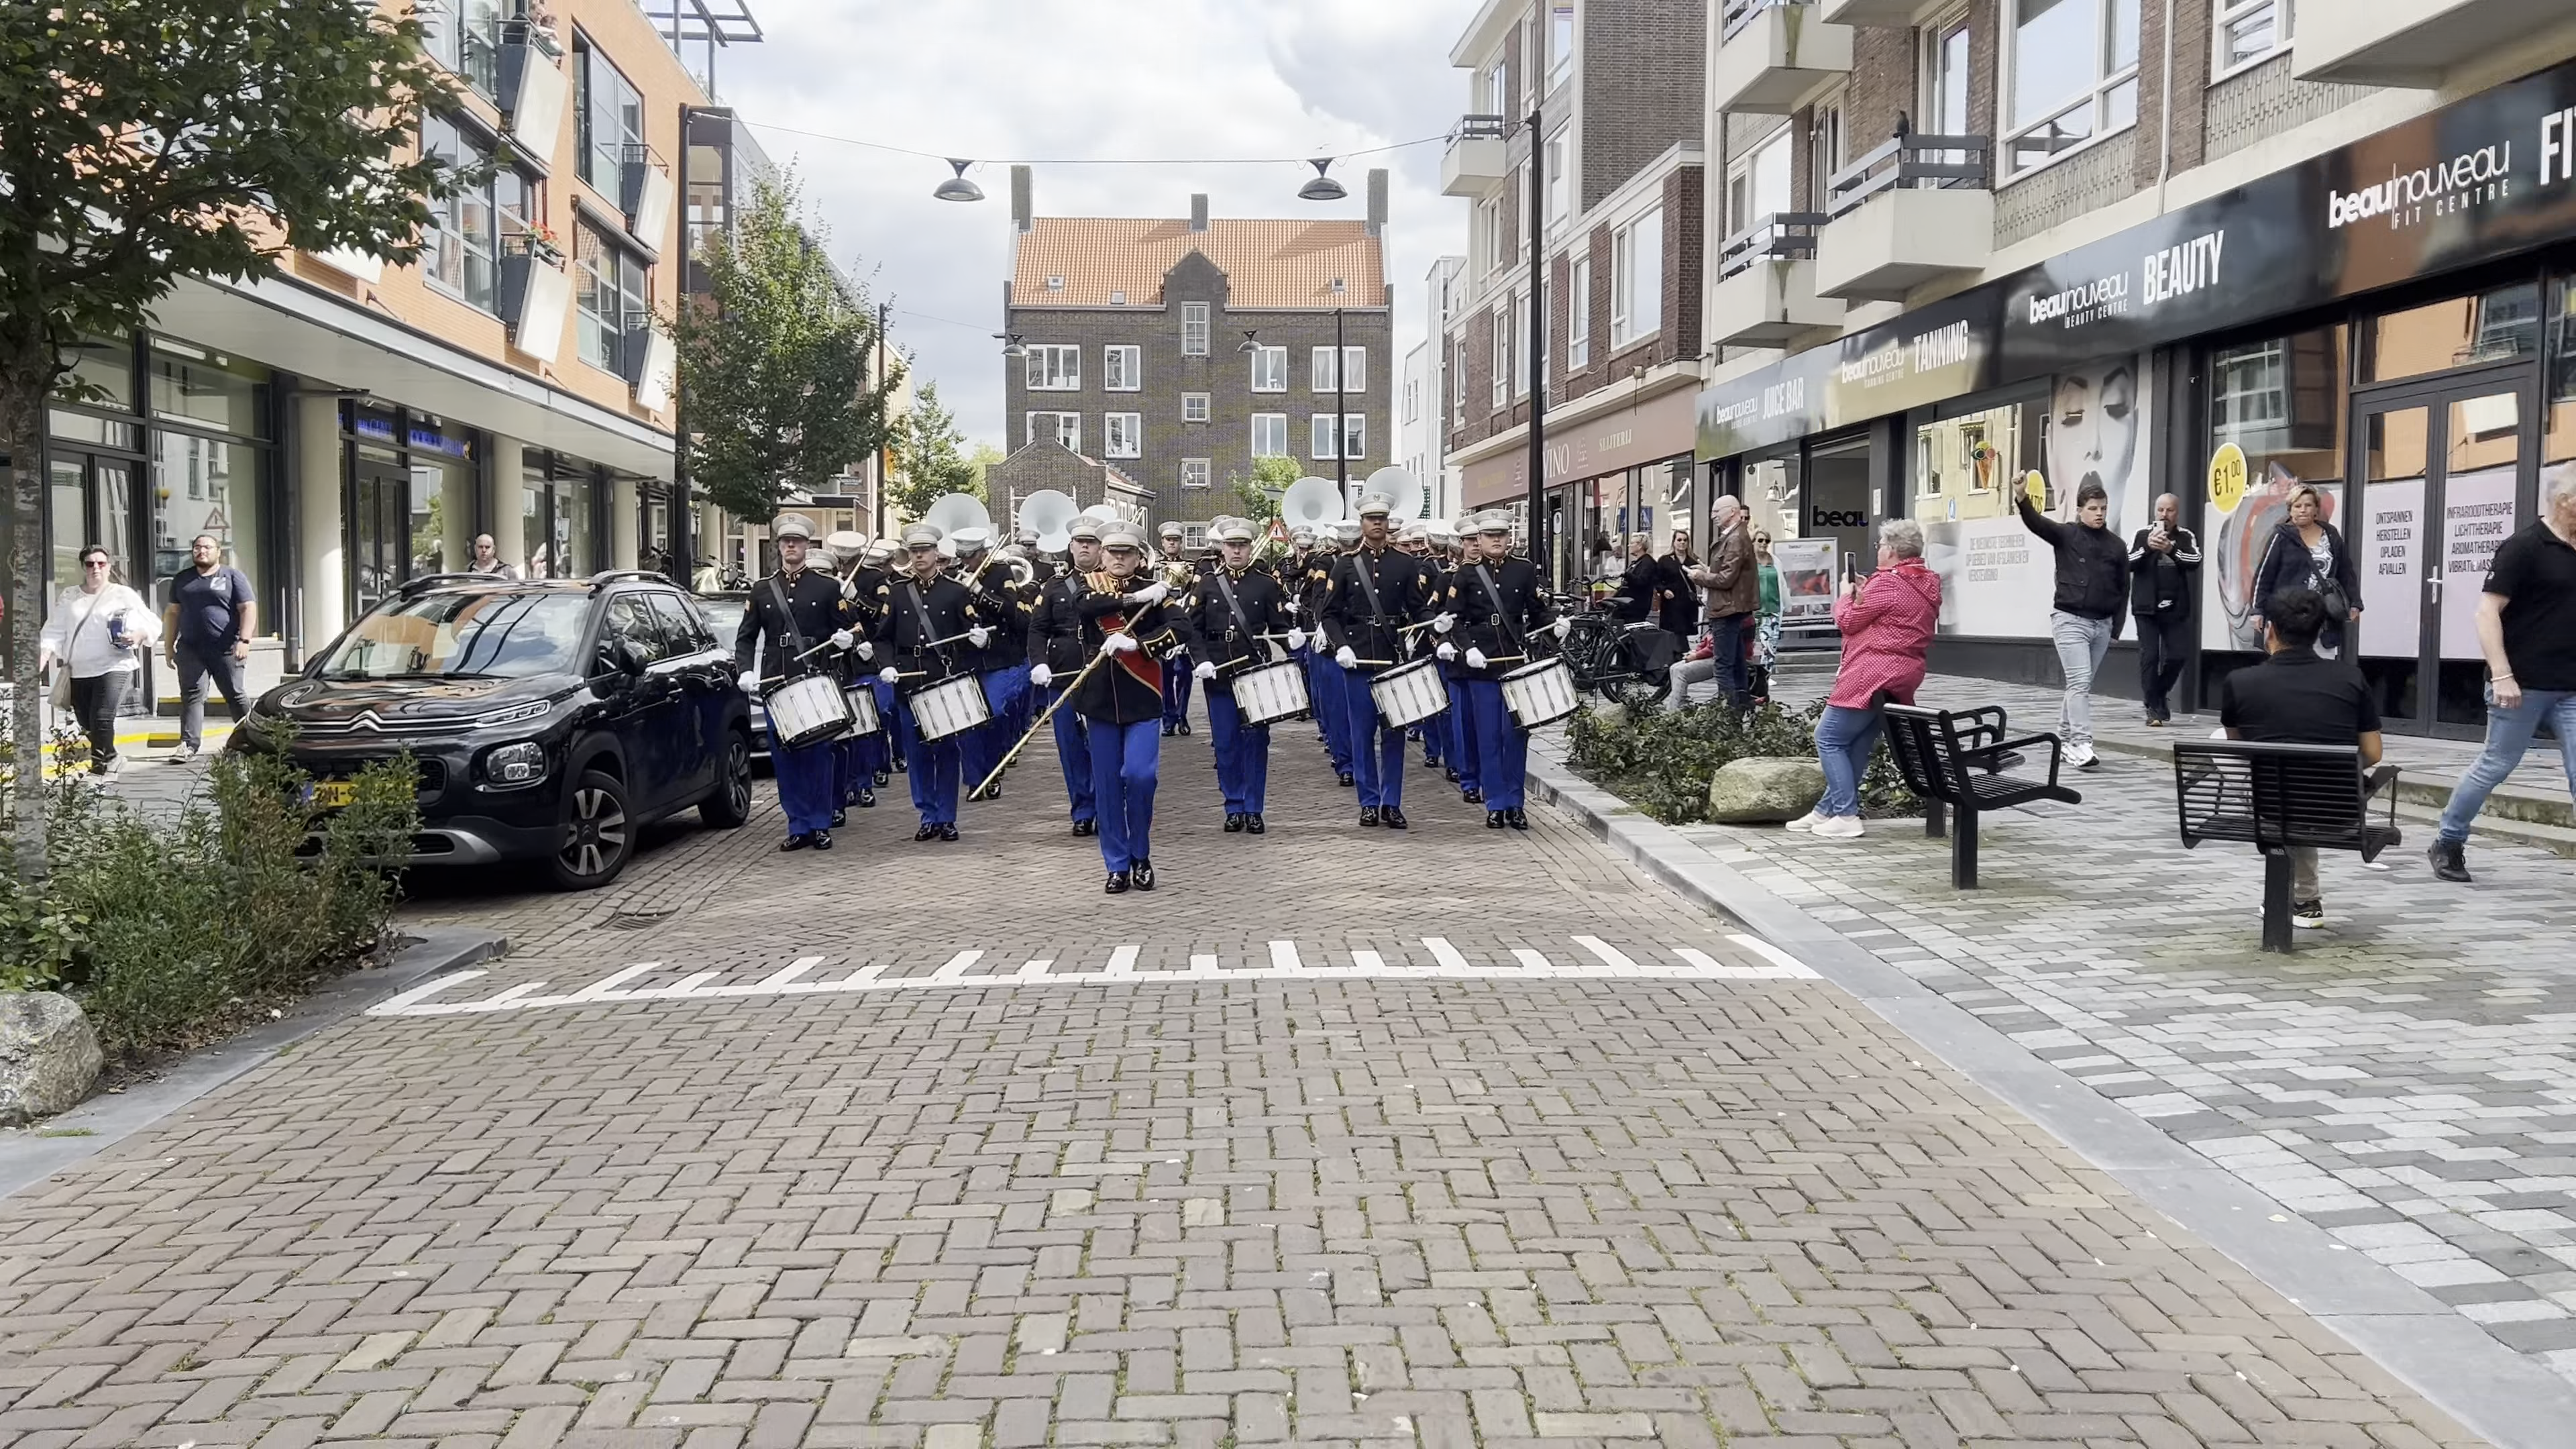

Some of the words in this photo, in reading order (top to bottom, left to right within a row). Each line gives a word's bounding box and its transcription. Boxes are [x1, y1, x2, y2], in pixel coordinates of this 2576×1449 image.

[2540, 105, 2576, 185] FI
[2394, 206, 2421, 229] FIT
[2436, 178, 2510, 216] CENTRE
[2143, 230, 2224, 305] BEAUTY
[2065, 311, 2094, 329] BEAUTY
[2098, 299, 2128, 319] CENTRE
[1914, 319, 1970, 374] TANNING
[1762, 382, 1785, 420] JUICE
[1786, 376, 1804, 413] BAR
[1599, 429, 1632, 452] SLIJTERIJ
[2375, 510, 2413, 525] ONTSPANNEN
[2447, 501, 2513, 519] INFRAROODTHERAPIE
[2376, 527, 2412, 541] HERSTELLEN
[2454, 521, 2503, 537] LICHTTHERAPIE
[2380, 545, 2406, 558] OPLADEN
[2378, 562, 2407, 575] AFVALLEN
